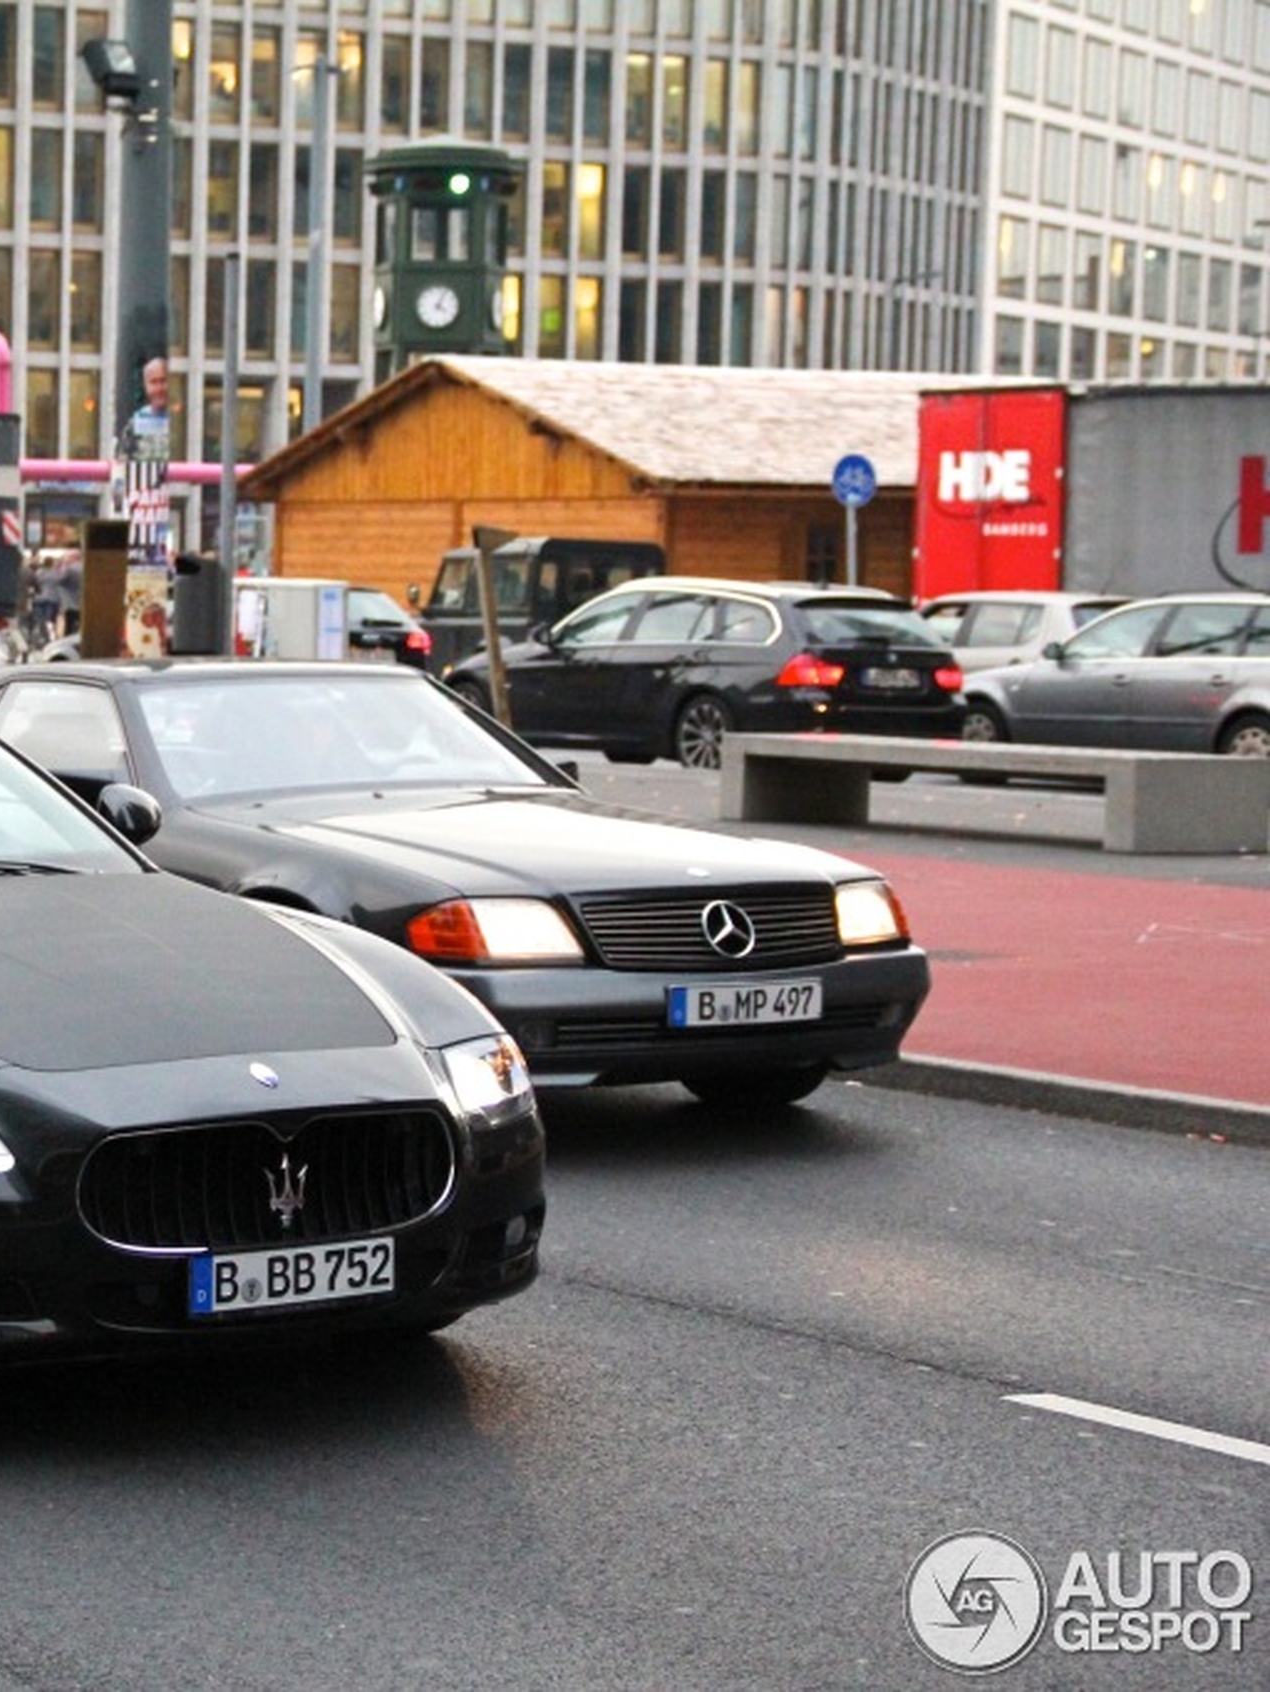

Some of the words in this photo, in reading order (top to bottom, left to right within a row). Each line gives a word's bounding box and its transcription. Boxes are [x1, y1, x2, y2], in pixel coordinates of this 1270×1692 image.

[939, 450, 1031, 502] HDE
[698, 991, 716, 1021] B
[734, 988, 767, 1019] MP
[773, 985, 814, 1017] 497
[215, 1261, 239, 1304] B
[267, 1252, 316, 1298] BB
[324, 1243, 391, 1291] 752
